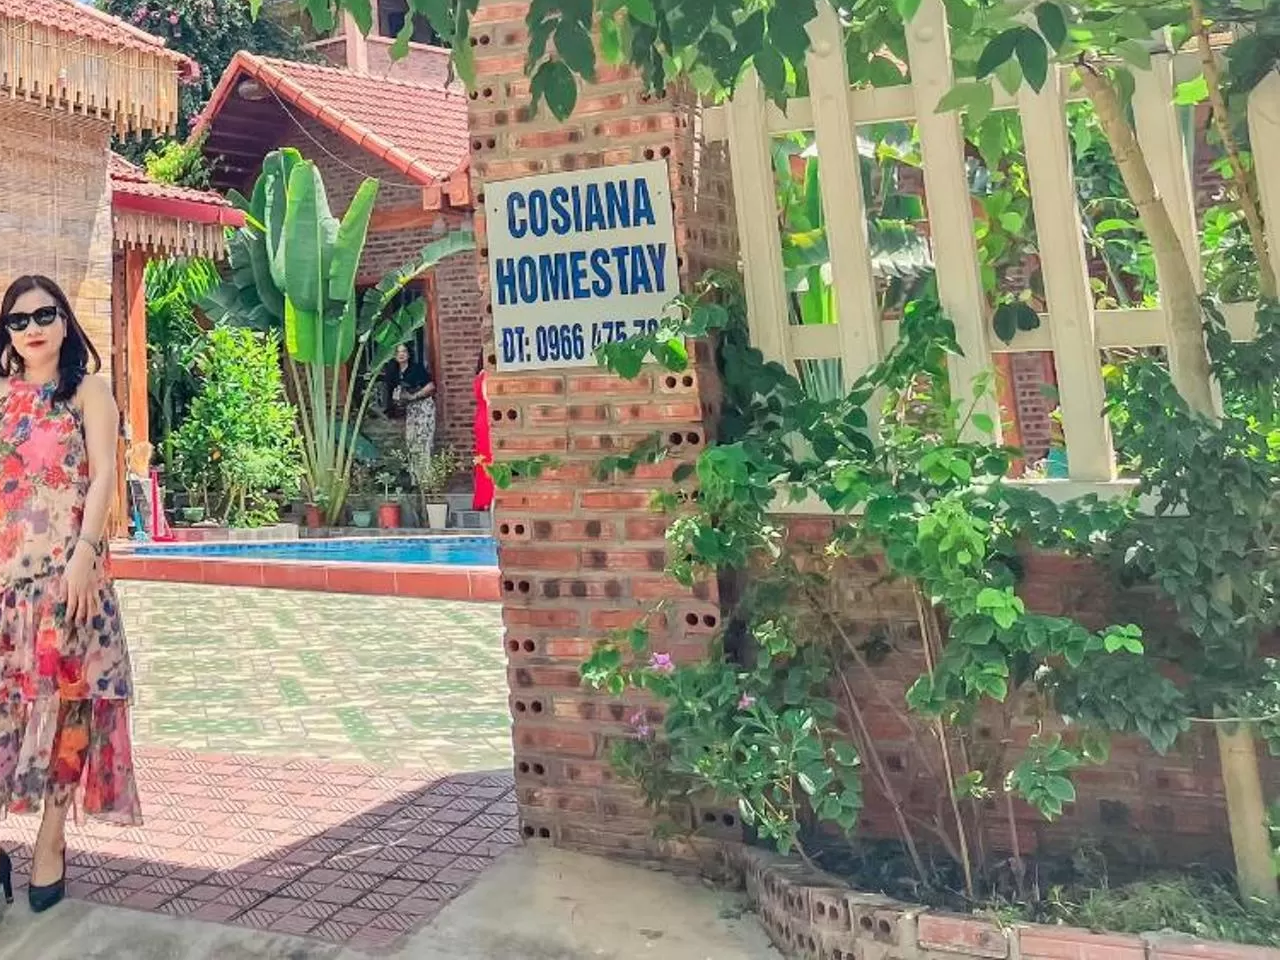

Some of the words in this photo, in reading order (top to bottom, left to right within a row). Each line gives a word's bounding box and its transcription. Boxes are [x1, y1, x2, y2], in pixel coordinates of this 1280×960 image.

[507, 178, 656, 238] COSIANA
[496, 243, 667, 305] HOMESTAY
[535, 323, 584, 362] 0966
